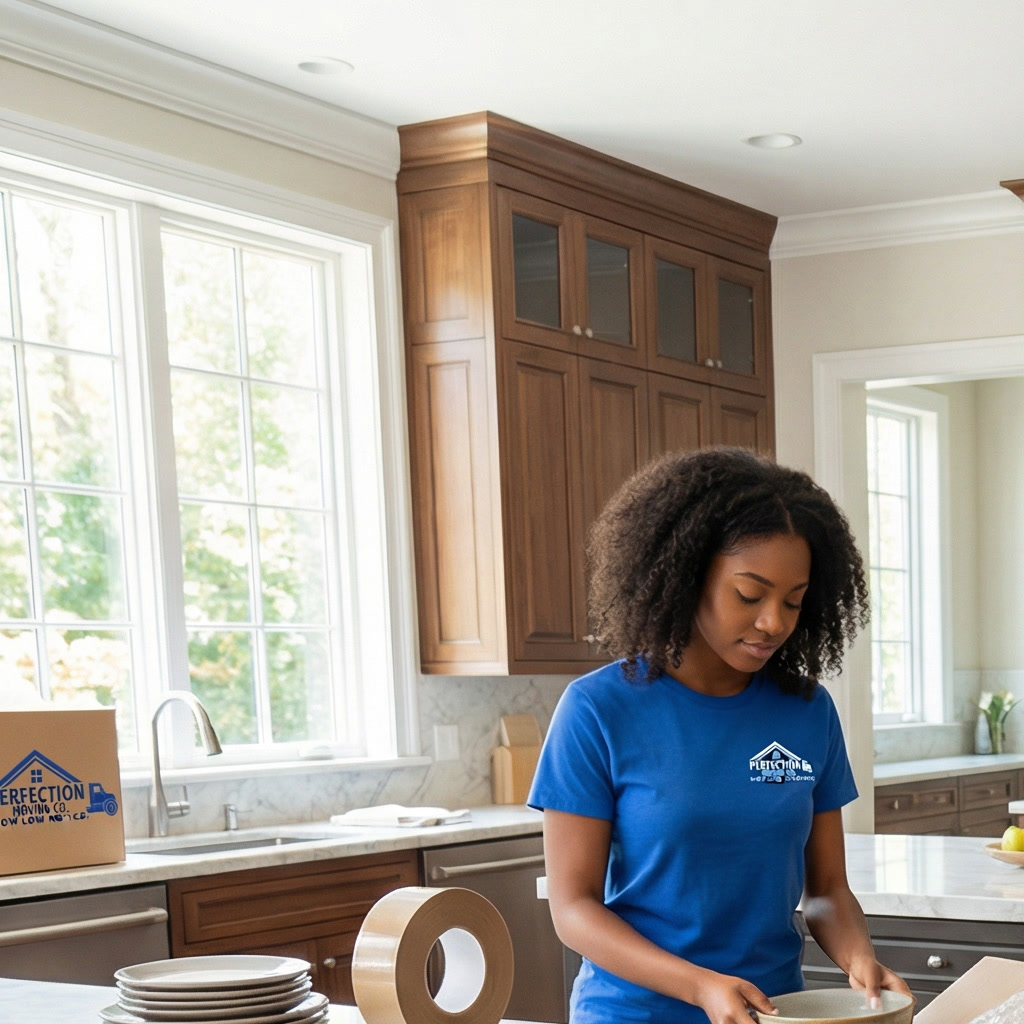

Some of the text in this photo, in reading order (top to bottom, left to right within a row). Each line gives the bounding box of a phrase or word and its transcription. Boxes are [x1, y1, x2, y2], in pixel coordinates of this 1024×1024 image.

[0, 783, 85, 805] ERFECTION
[0, 817, 18, 827] OW
[22, 816, 44, 825] LOW
